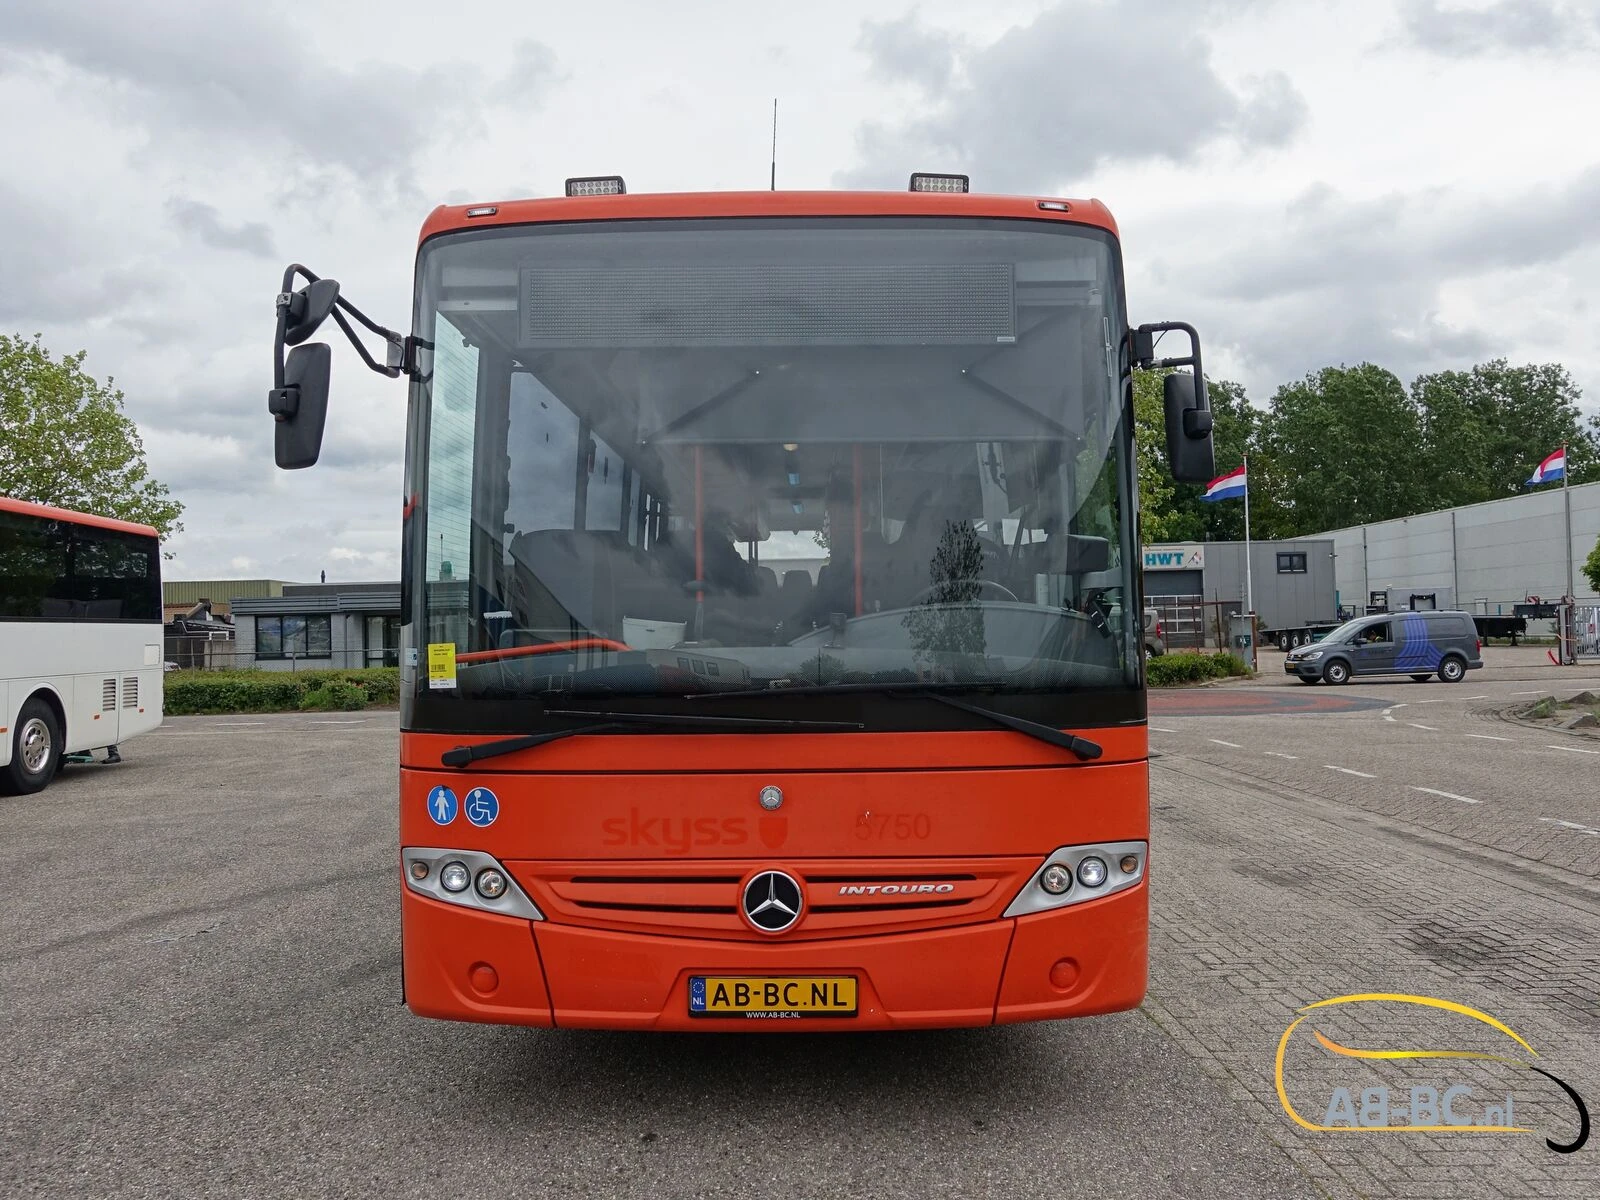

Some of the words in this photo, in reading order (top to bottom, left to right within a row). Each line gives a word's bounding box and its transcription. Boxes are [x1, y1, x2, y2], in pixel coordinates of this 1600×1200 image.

[1145, 553, 1184, 565] HWT
[601, 807, 749, 854] skyss
[855, 813, 931, 840] 5750
[839, 884, 955, 897] INTOURO
[712, 983, 847, 1006] AB-BC.NL
